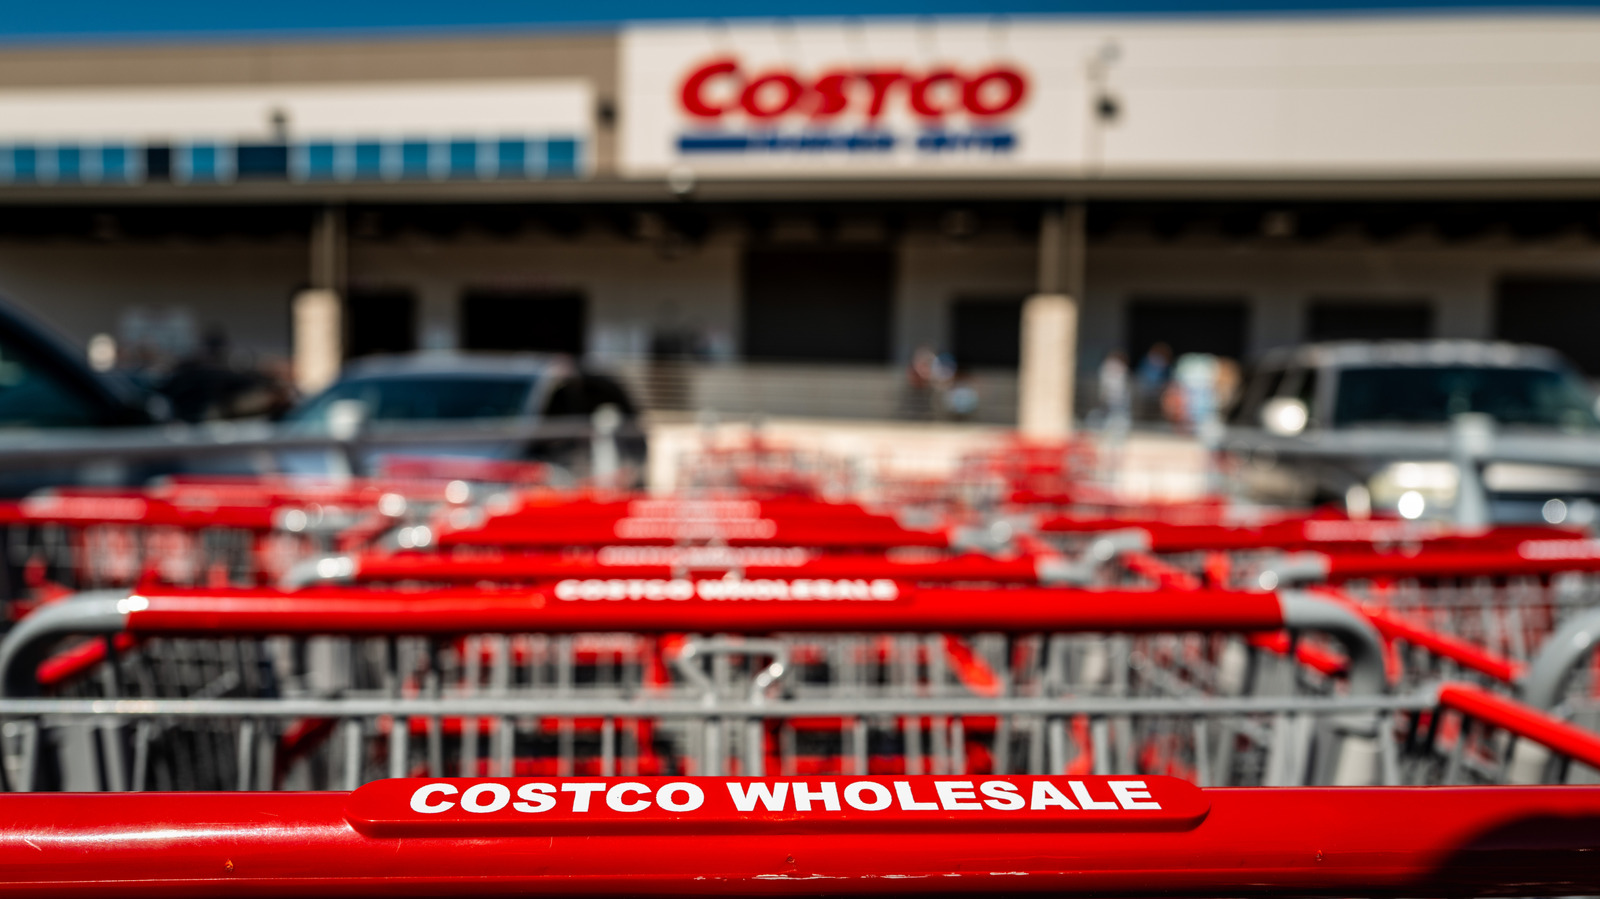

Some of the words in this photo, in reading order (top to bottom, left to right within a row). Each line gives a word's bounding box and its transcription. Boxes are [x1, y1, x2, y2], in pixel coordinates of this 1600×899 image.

[679, 58, 1027, 120] COSTCO
[556, 579, 694, 601] COSTCO
[697, 579, 897, 601] WHOLESALE
[410, 782, 704, 813] COSTCO
[726, 781, 1162, 811] WHOLESALE
